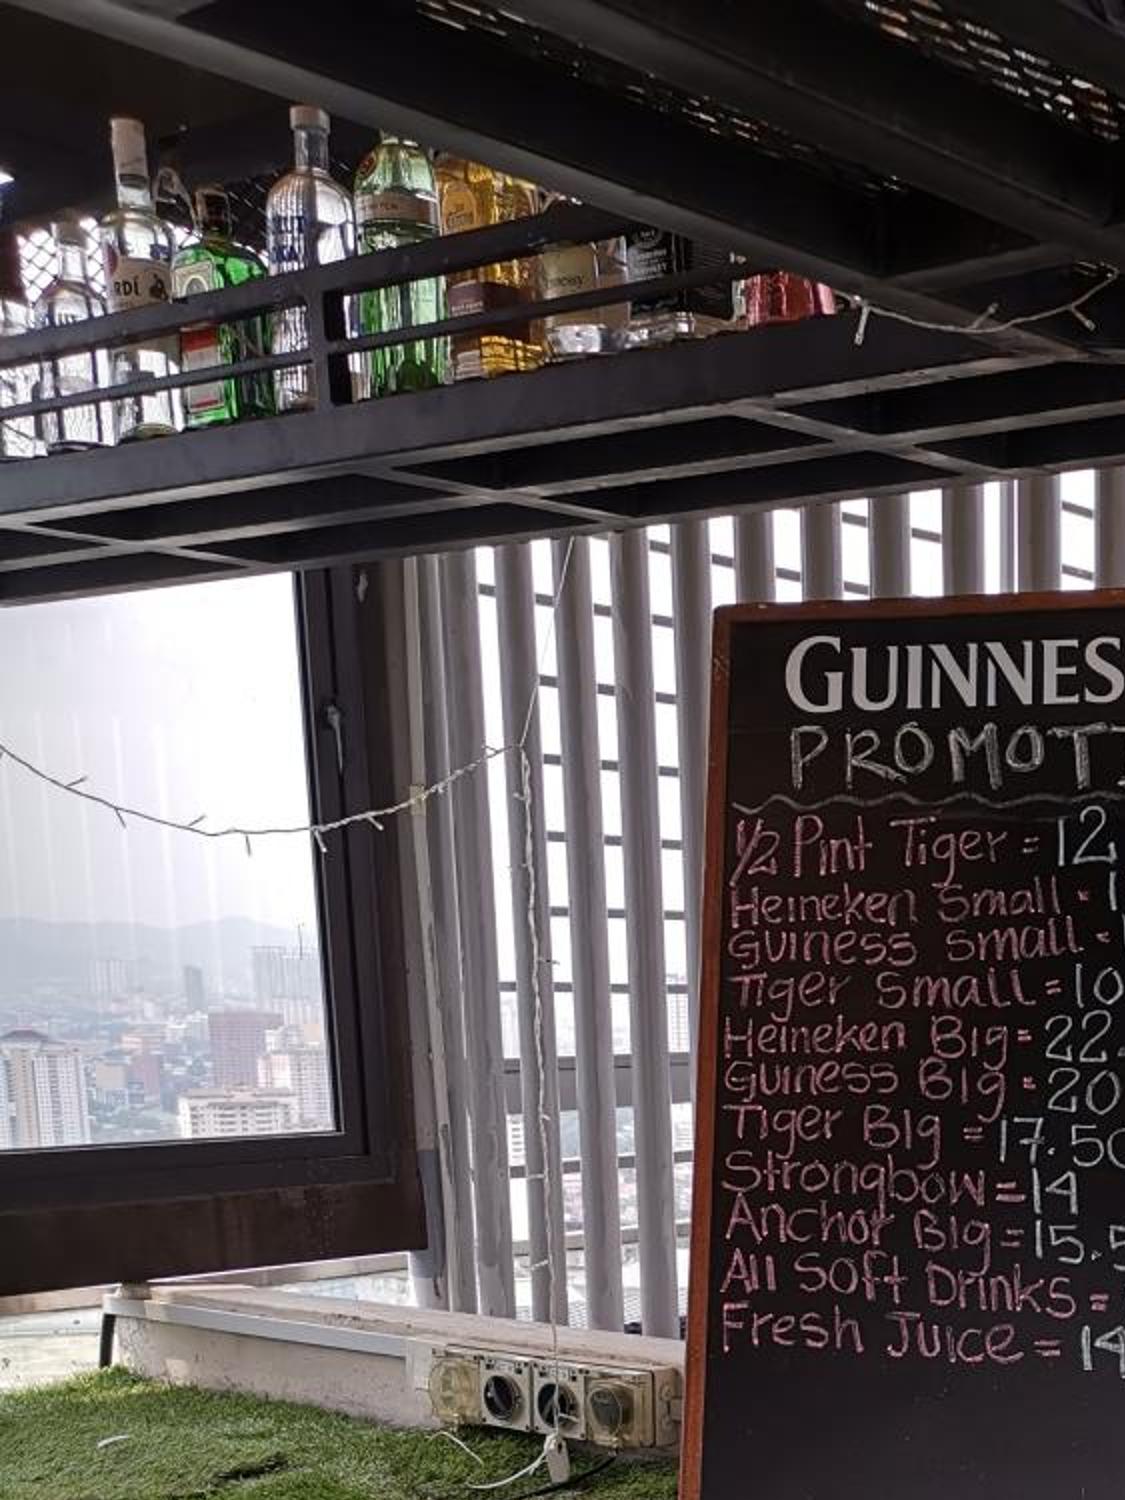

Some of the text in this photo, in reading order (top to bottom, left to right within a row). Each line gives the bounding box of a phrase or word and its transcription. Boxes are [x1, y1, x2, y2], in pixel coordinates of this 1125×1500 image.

[794, 814, 873, 878] Pint
[889, 816, 1009, 888] Tiger
[1058, 805, 1118, 867] 12
[730, 882, 918, 929] Heineken
[936, 874, 1062, 924] Small
[728, 971, 852, 1023] Tiger
[875, 967, 1037, 1009] Small
[723, 1014, 906, 1059] Heineken
[930, 1015, 1008, 1069] Big
[918, 1057, 1006, 1123] Big
[1047, 1067, 1121, 1115] 20
[721, 1104, 843, 1160] Tiger
[863, 1104, 941, 1171] Big
[726, 1192, 896, 1246] Anchor
[913, 1209, 992, 1278] Big
[720, 1248, 777, 1294] All
[722, 1300, 865, 1353] Fresh
[886, 1311, 1025, 1364] Juice
